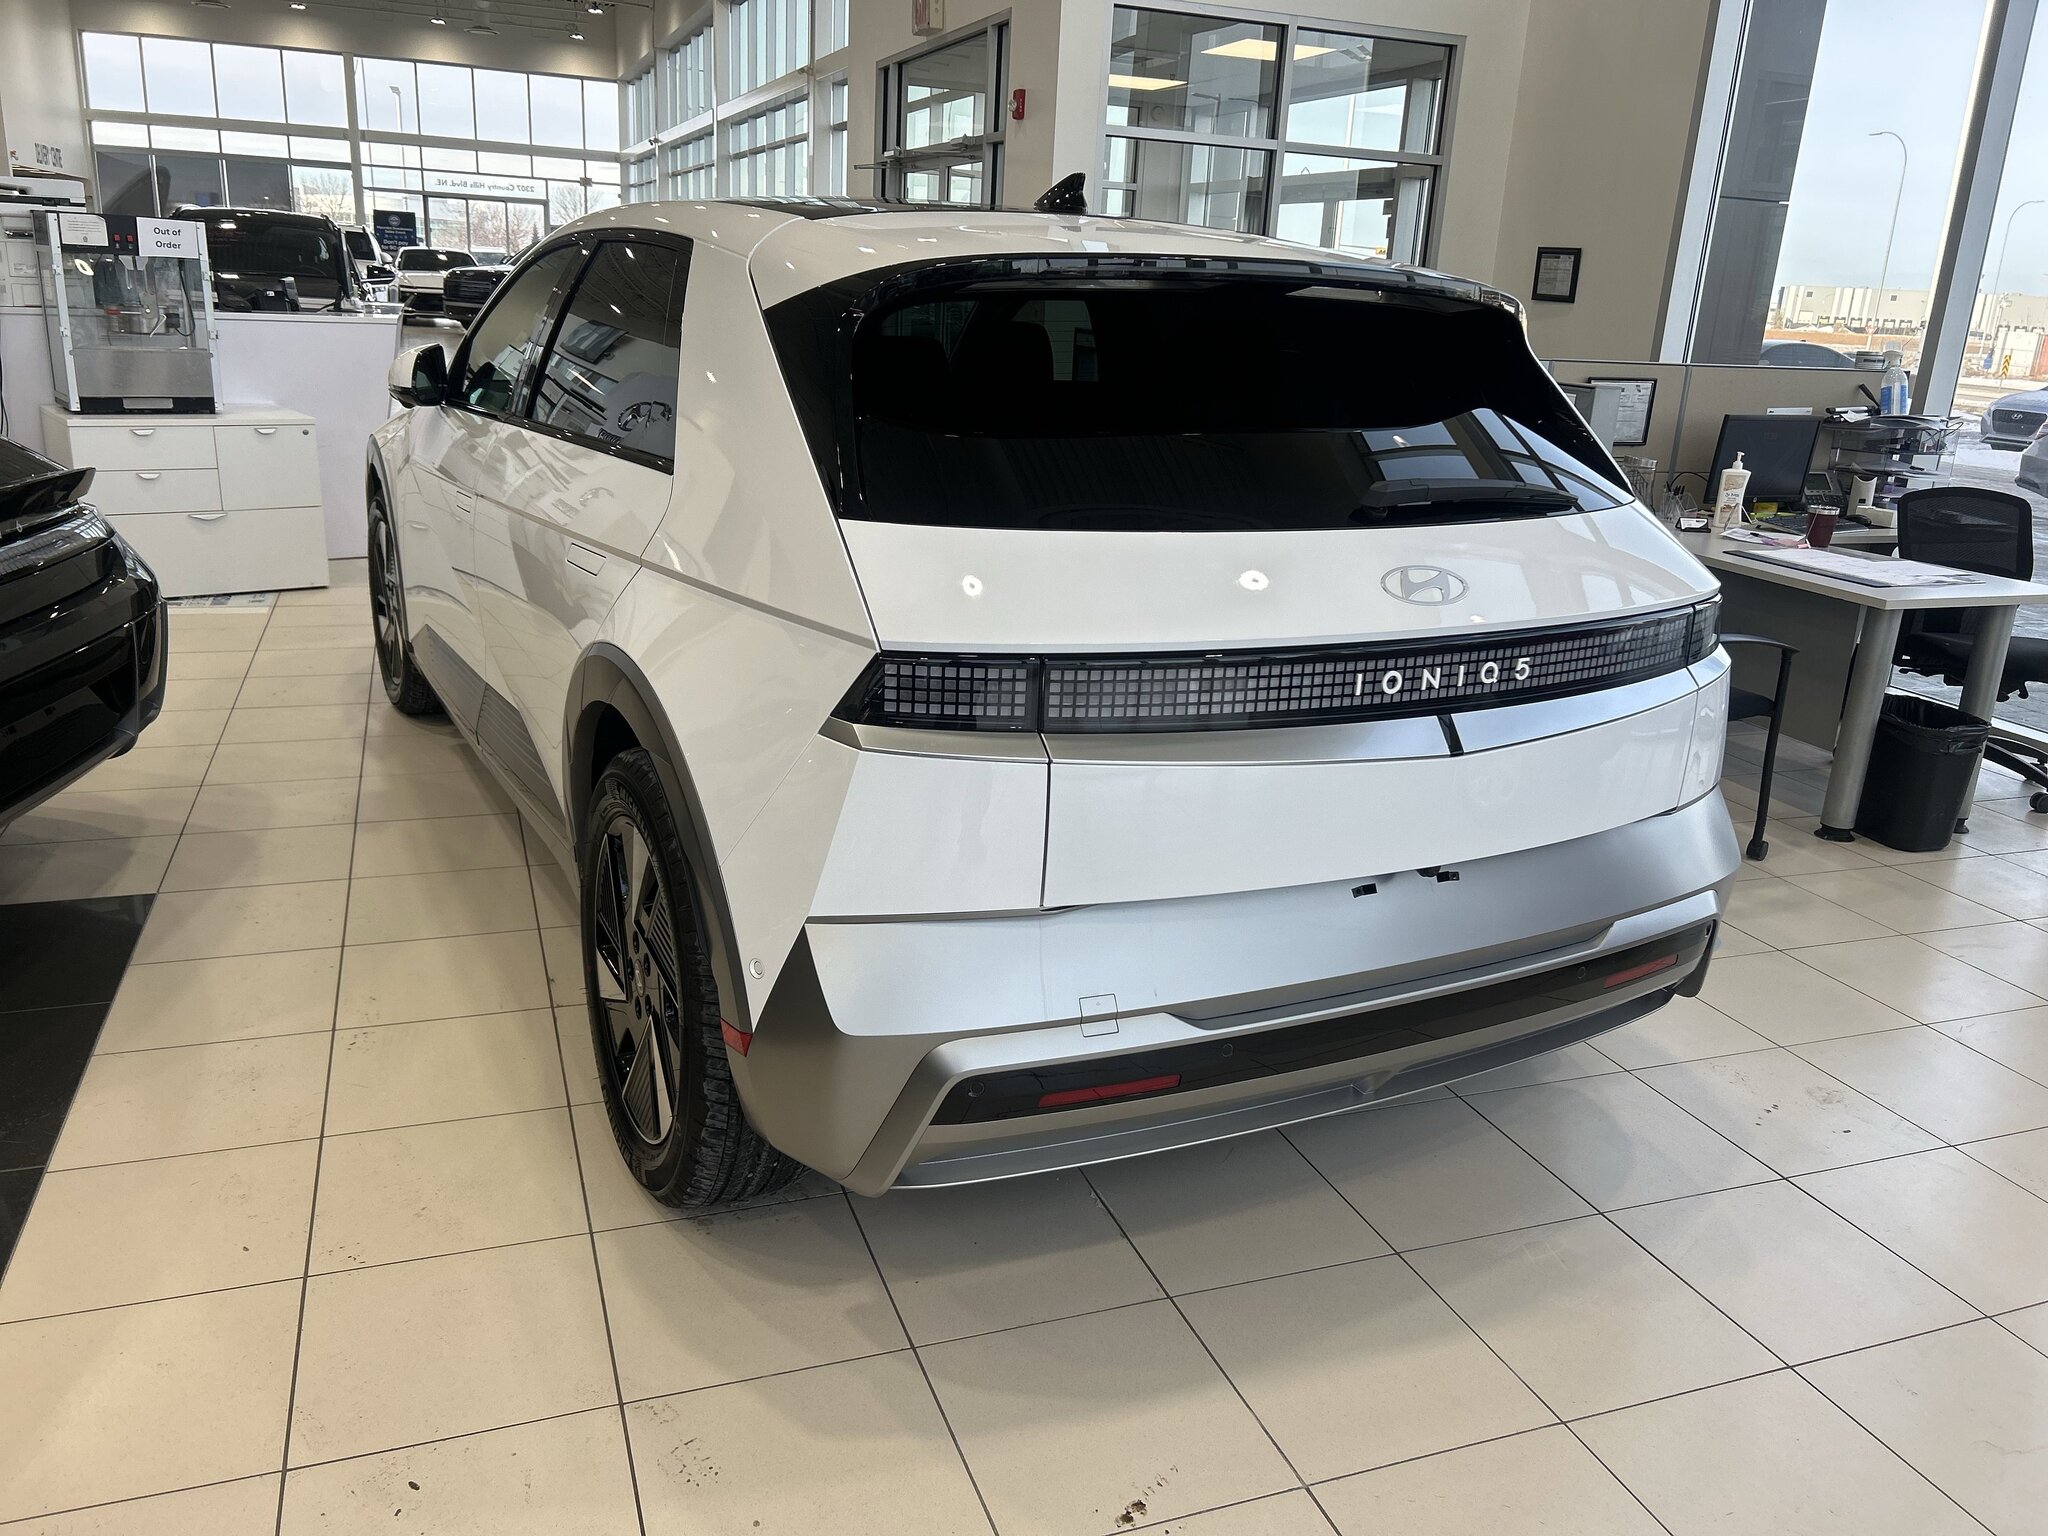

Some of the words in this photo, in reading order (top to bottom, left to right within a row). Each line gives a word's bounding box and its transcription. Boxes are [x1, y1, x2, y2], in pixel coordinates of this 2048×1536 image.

[154, 227, 170, 235] Out
[155, 240, 181, 249] Order
[1355, 661, 1499, 696] IONIQ
[1514, 657, 1531, 681] 5
